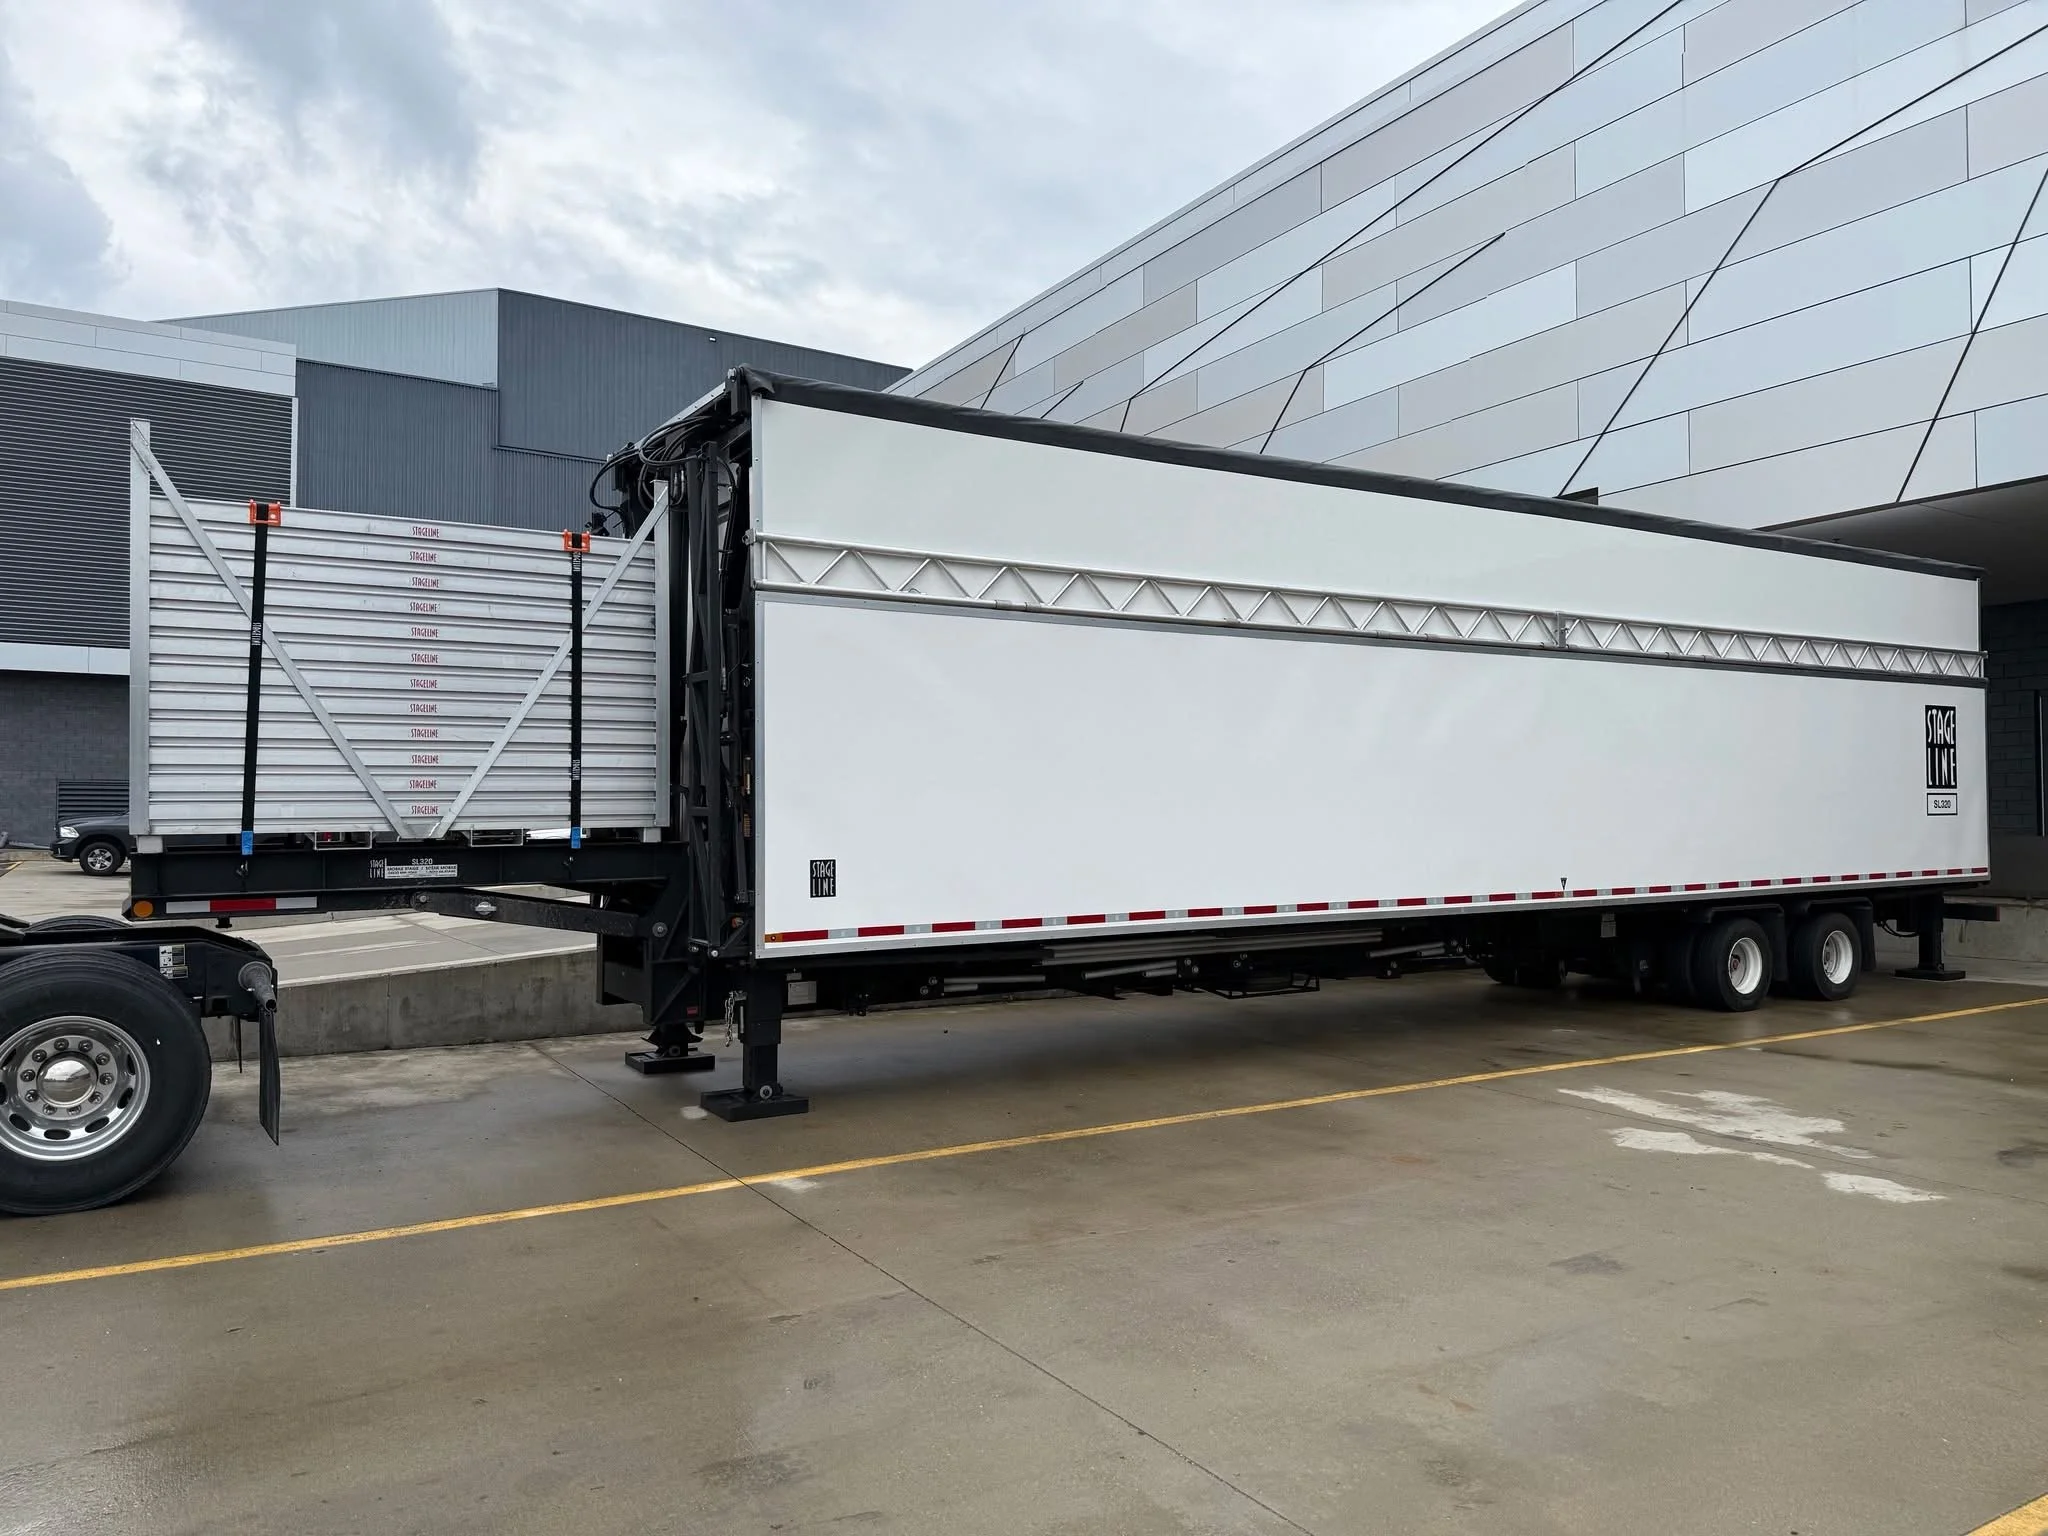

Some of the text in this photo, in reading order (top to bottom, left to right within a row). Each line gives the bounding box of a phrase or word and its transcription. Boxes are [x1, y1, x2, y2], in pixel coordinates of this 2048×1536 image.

[412, 526, 439, 538] STAGELINE
[409, 551, 437, 563] STAGELINE
[412, 576, 439, 588] STAGELINE
[409, 601, 437, 613] STAGELINE
[411, 627, 438, 638] STAGELINE
[411, 653, 438, 664] STAGELINE
[410, 679, 438, 689] STAGELINE
[410, 703, 438, 713] STAGELINE
[1927, 708, 1955, 745] STAGE
[411, 728, 439, 738] STAGELINE
[411, 755, 439, 764] STAGELINE
[1927, 747, 1955, 786] LINE
[409, 780, 437, 789] STAGELINE
[1933, 799, 1952, 809] SL320
[411, 805, 439, 815] STAGELINE
[812, 860, 834, 878] STAGE
[812, 878, 834, 897] LINE
